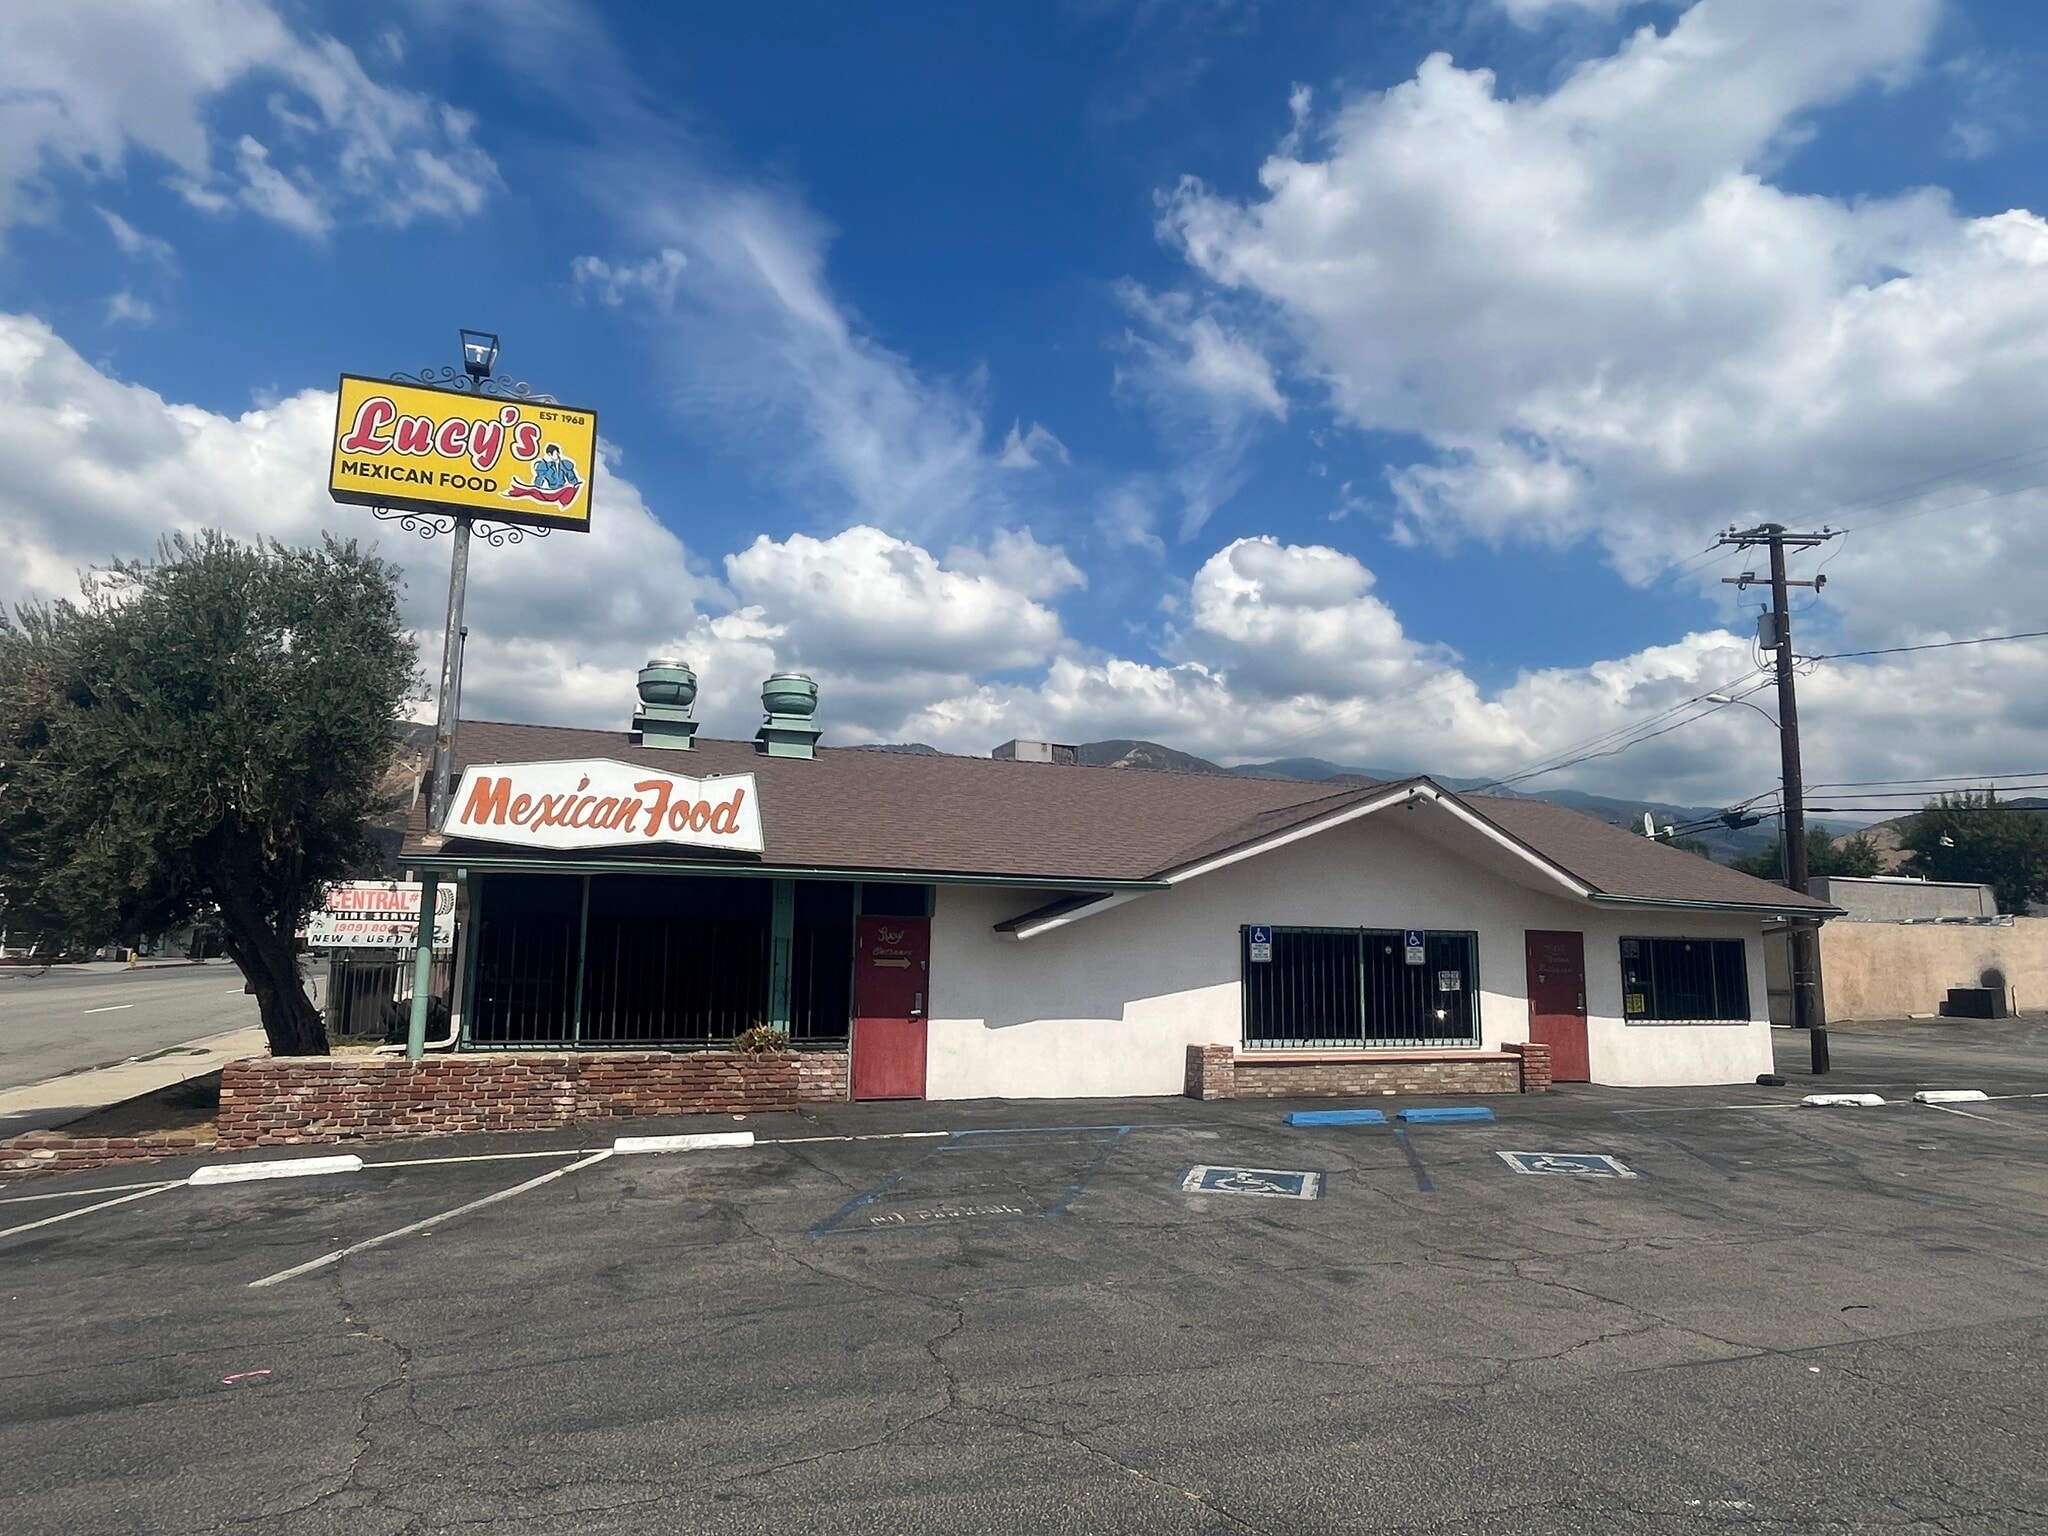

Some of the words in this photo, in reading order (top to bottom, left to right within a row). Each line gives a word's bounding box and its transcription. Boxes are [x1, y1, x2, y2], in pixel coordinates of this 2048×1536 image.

[539, 411, 559, 423] EST
[561, 414, 585, 426] 1968
[340, 396, 541, 472] Lucy's
[341, 460, 433, 485] MEXICAN
[439, 473, 498, 494] FOOD
[460, 773, 636, 833] Mexican
[634, 780, 745, 836] Food
[328, 889, 410, 911] CENTRAL
[337, 912, 367, 921] TIRE
[373, 913, 421, 921] SERVIC
[334, 923, 368, 932] (909)
[311, 934, 344, 943] NEW
[366, 934, 403, 944] USED
